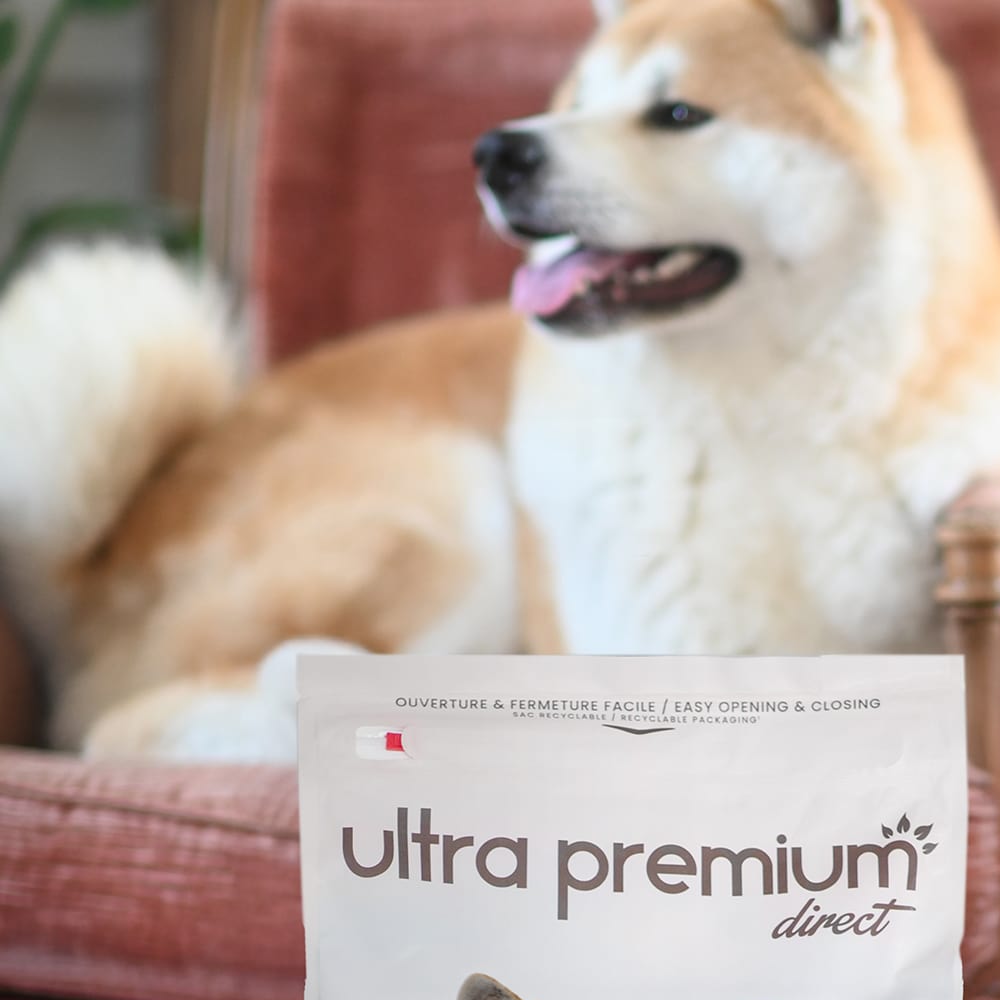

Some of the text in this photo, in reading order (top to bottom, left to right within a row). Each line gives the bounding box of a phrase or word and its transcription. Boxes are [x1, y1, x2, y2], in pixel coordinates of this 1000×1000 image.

[396, 698, 880, 714] OUVERTURE & FERMETURE FACILE / EASY OPENING & CLOSING
[621, 715, 687, 723] RECYCLABLE
[342, 807, 919, 920] ultra premium
[771, 897, 916, 940] direct
